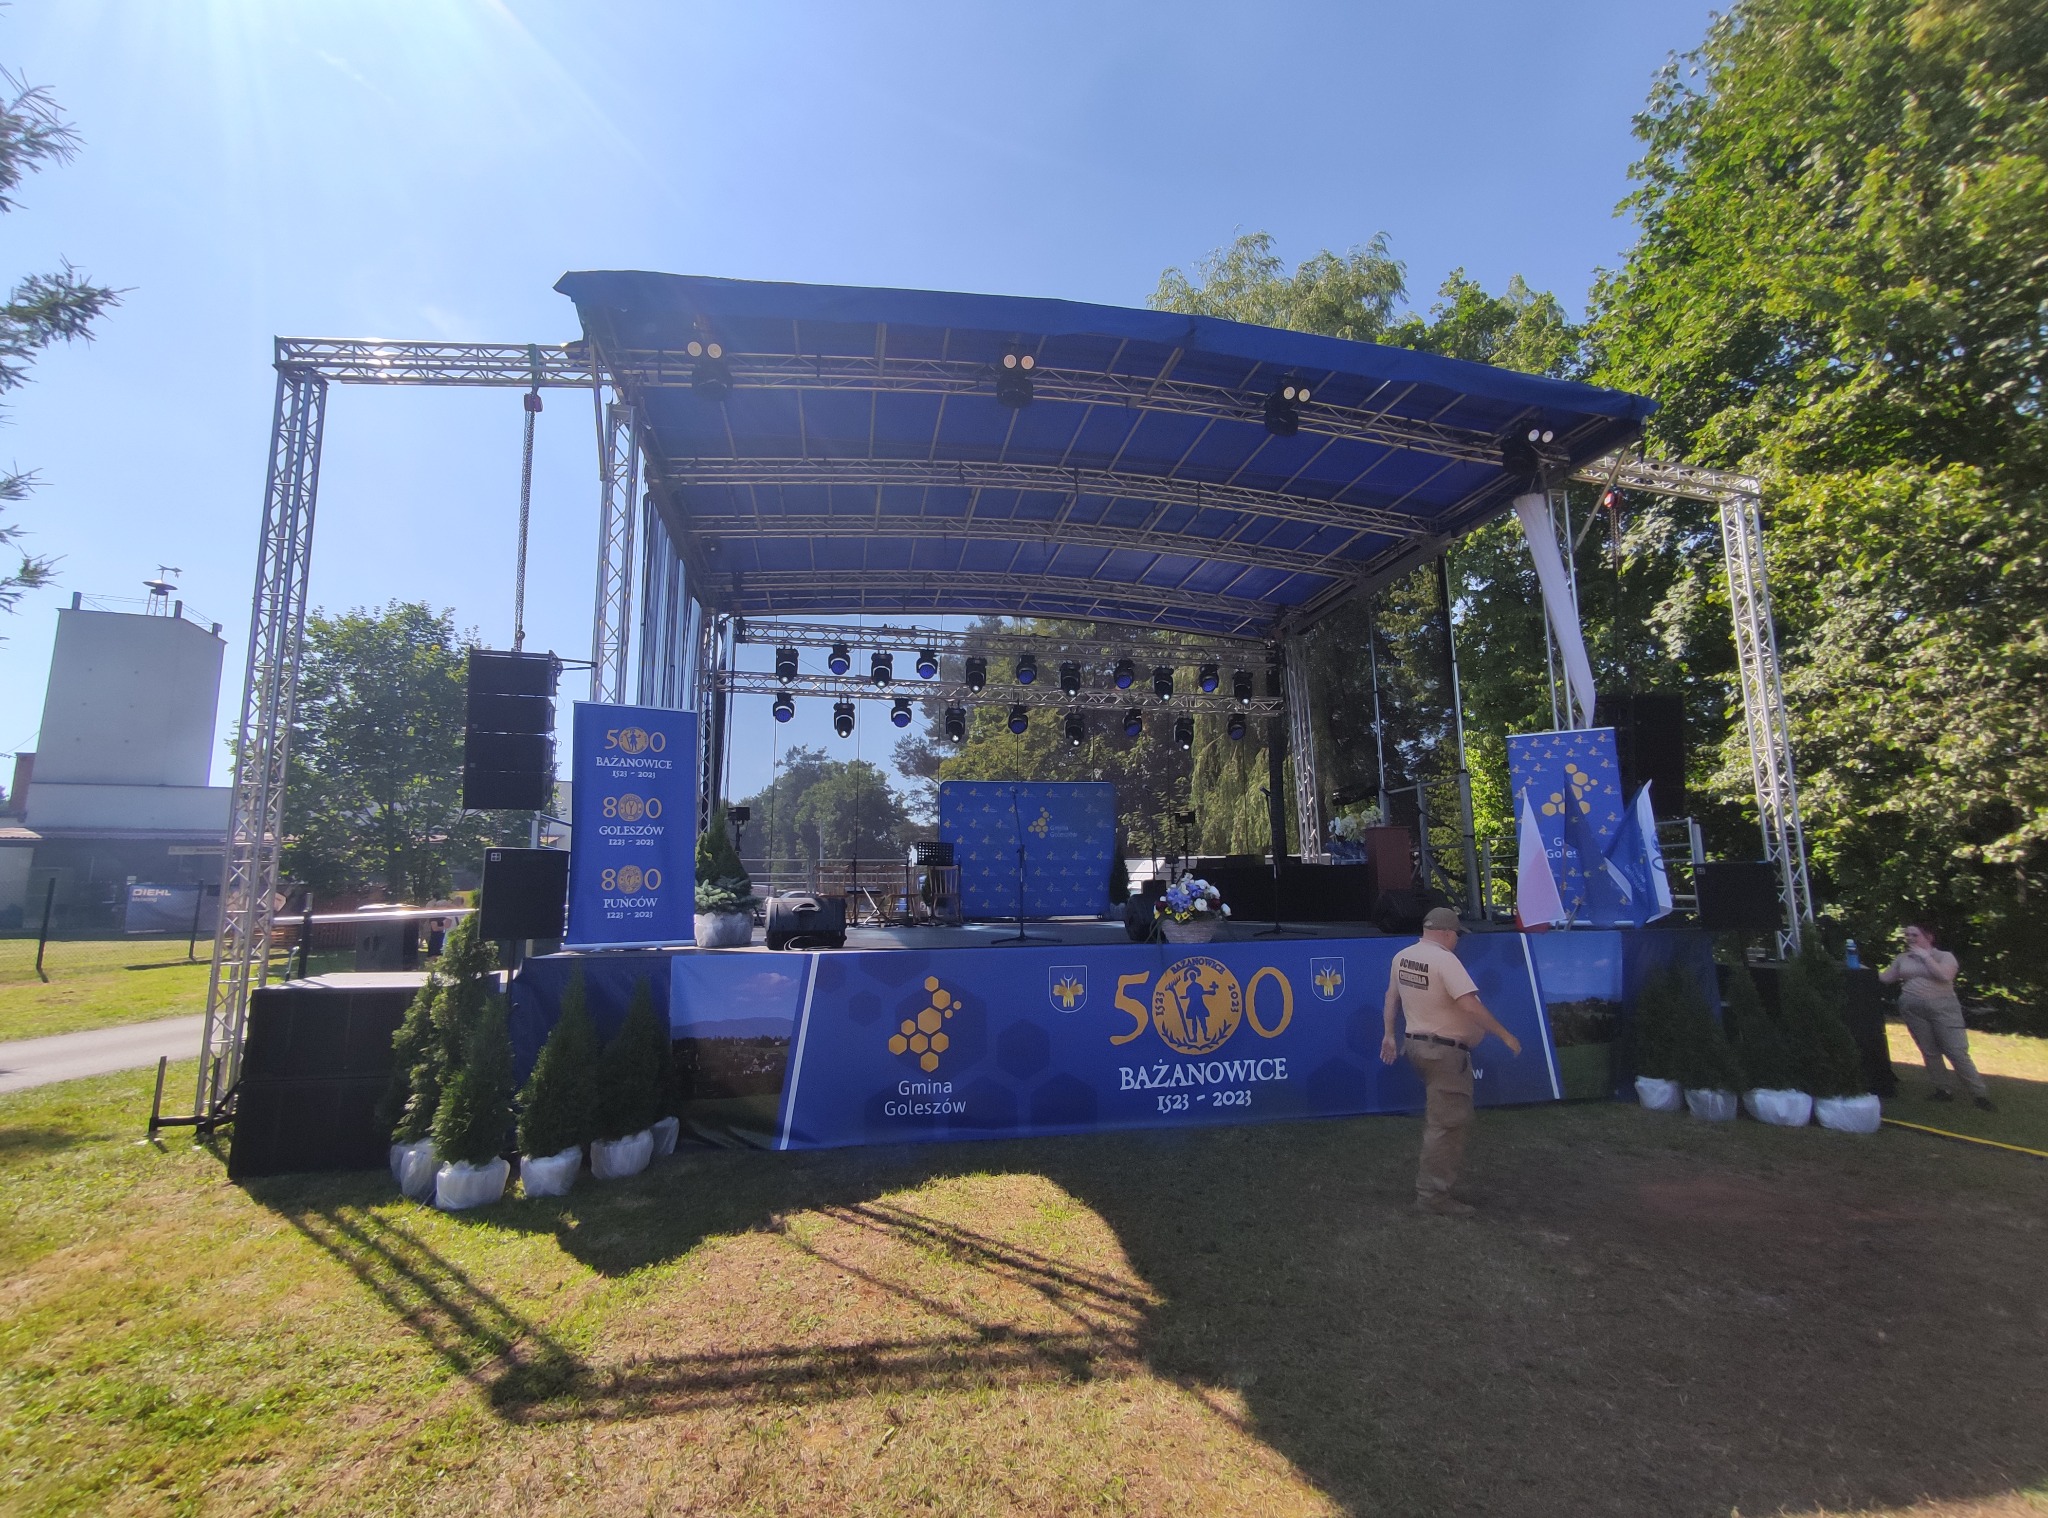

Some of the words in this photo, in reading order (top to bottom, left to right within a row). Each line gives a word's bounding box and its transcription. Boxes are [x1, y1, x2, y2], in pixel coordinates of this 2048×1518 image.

[595, 754, 673, 770] BAŻANOWICE
[612, 770, 628, 778] 1523
[637, 771, 656, 779] 2023
[599, 823, 665, 836] GOLESZÓW
[608, 838, 626, 847] 1223
[635, 838, 654, 847] 2023
[132, 888, 172, 897] DIEHL
[603, 895, 658, 909] PUŃCÓW
[606, 911, 624, 919] 1223
[634, 911, 653, 919] 2023
[1154, 991, 1165, 1017] 1523
[1227, 982, 1240, 1014] 2023
[1118, 1058, 1289, 1091] BAŻANOWICE
[898, 1078, 953, 1096] Gmina
[884, 1097, 967, 1116] Goleszów
[1156, 1093, 1190, 1114] 1523
[1212, 1090, 1252, 1107] 2023
